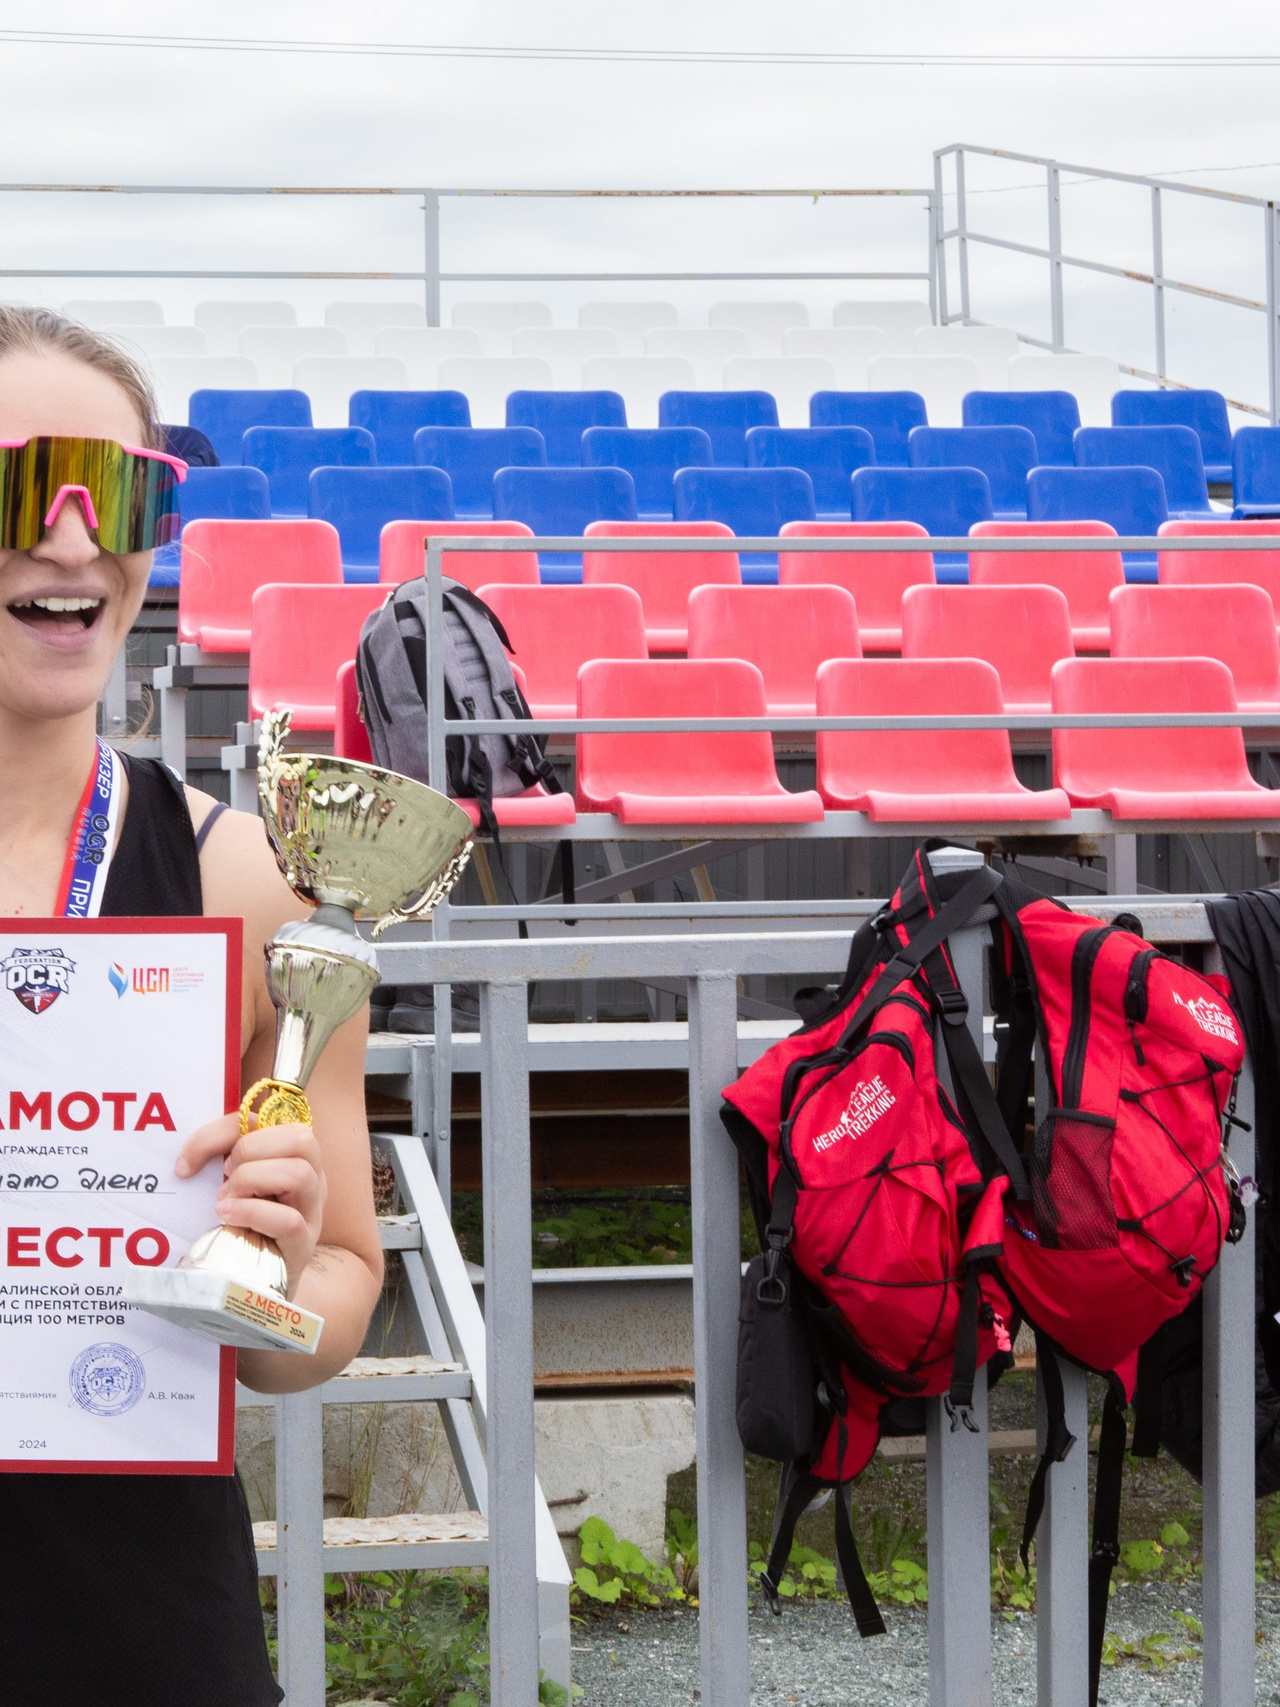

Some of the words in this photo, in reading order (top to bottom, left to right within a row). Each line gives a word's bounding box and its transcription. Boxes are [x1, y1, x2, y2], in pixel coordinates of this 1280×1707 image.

[66, 878, 91, 918] ПРИ
[13, 957, 62, 965] FEDERATION
[6, 964, 69, 994] OCR
[133, 967, 170, 995] ЦСП
[849, 1075, 887, 1118] LEAGUE
[846, 1089, 896, 1140] TREKKING
[812, 1124, 847, 1153] HERO
[84, 1286, 123, 1296] ОБЛА
[10, 1299, 20, 1310] С
[24, 1300, 140, 1311] ПРЕПЯТСТВИЯ
[244, 1290, 253, 1304] 2
[255, 1294, 302, 1325] МЕСТО
[38, 1314, 62, 1325] 100
[67, 1315, 125, 1325] МЕТРОВ
[289, 1326, 306, 1339] 2024
[147, 1392, 168, 1401] А.В.
[170, 1391, 196, 1401] Квак
[18, 1440, 47, 1450] 2024
